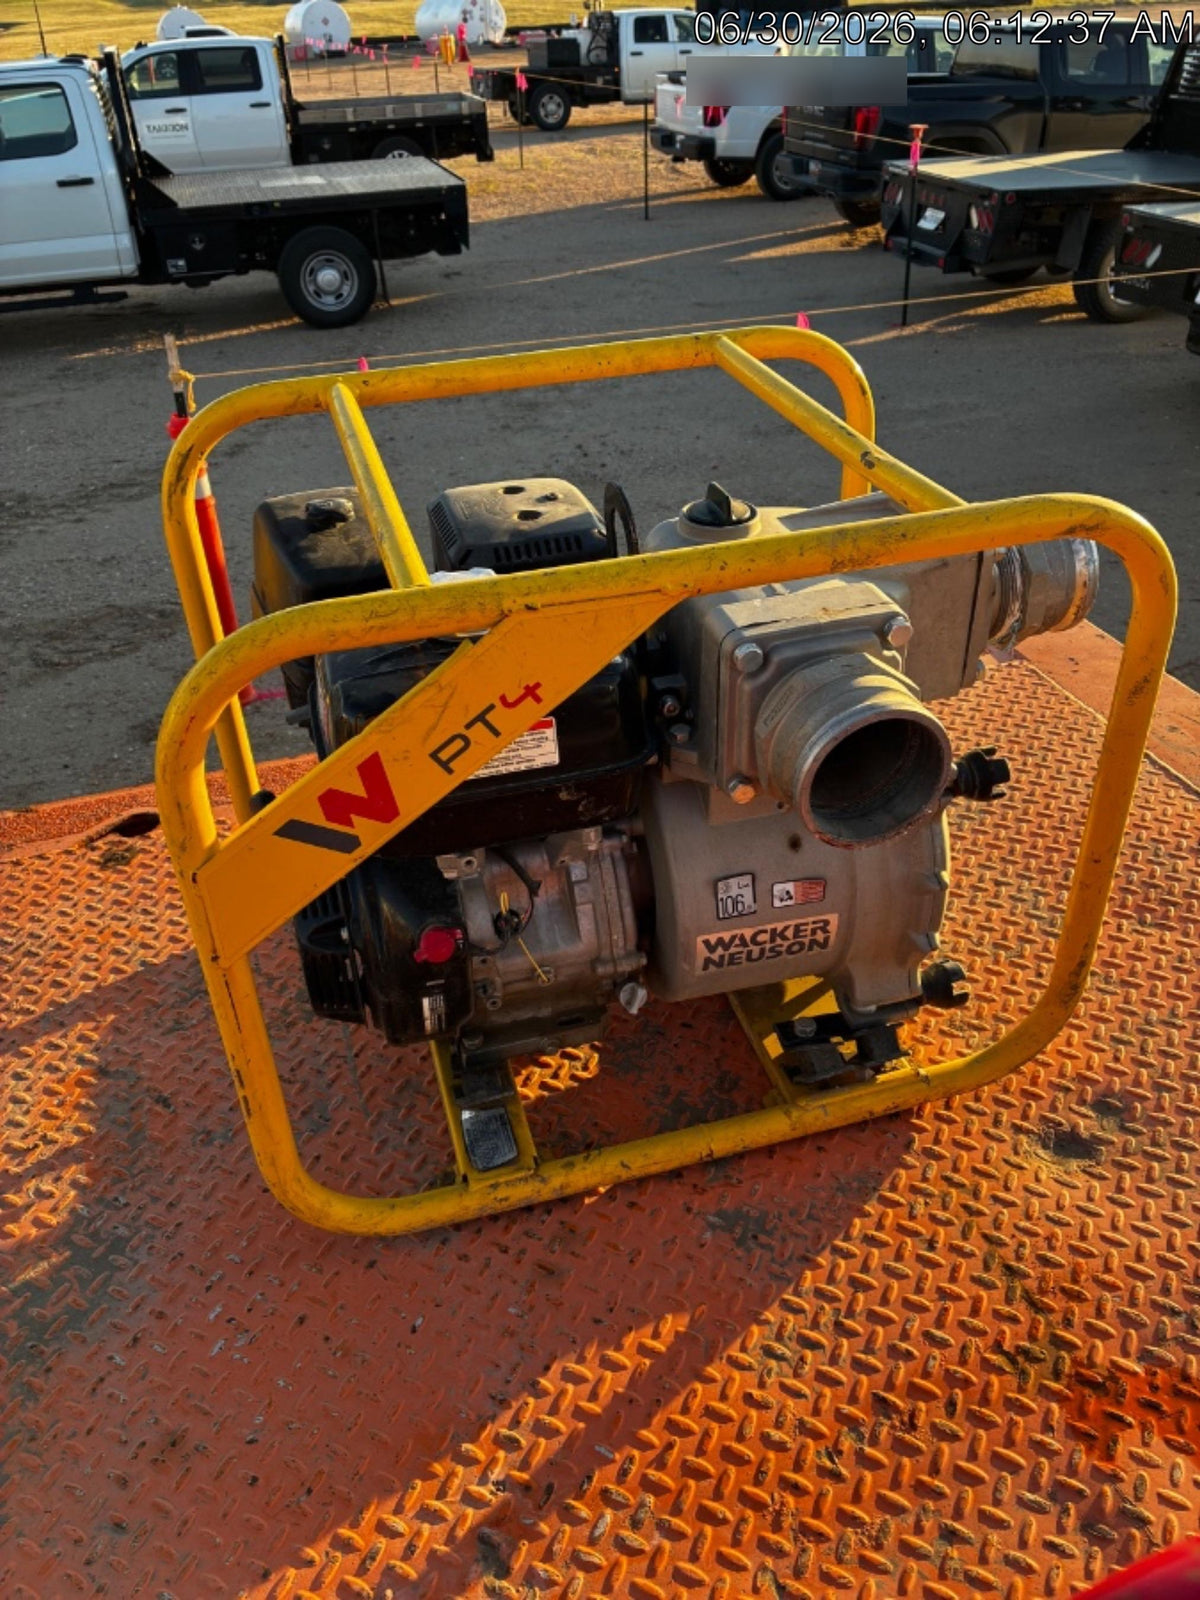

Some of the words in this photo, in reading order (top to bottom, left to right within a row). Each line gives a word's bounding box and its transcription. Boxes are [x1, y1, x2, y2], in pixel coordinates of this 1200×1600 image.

[428, 682, 543, 775] PT4
[719, 894, 746, 917] 106
[701, 919, 831, 955] WACKER
[701, 935, 831, 972] NEUSON
